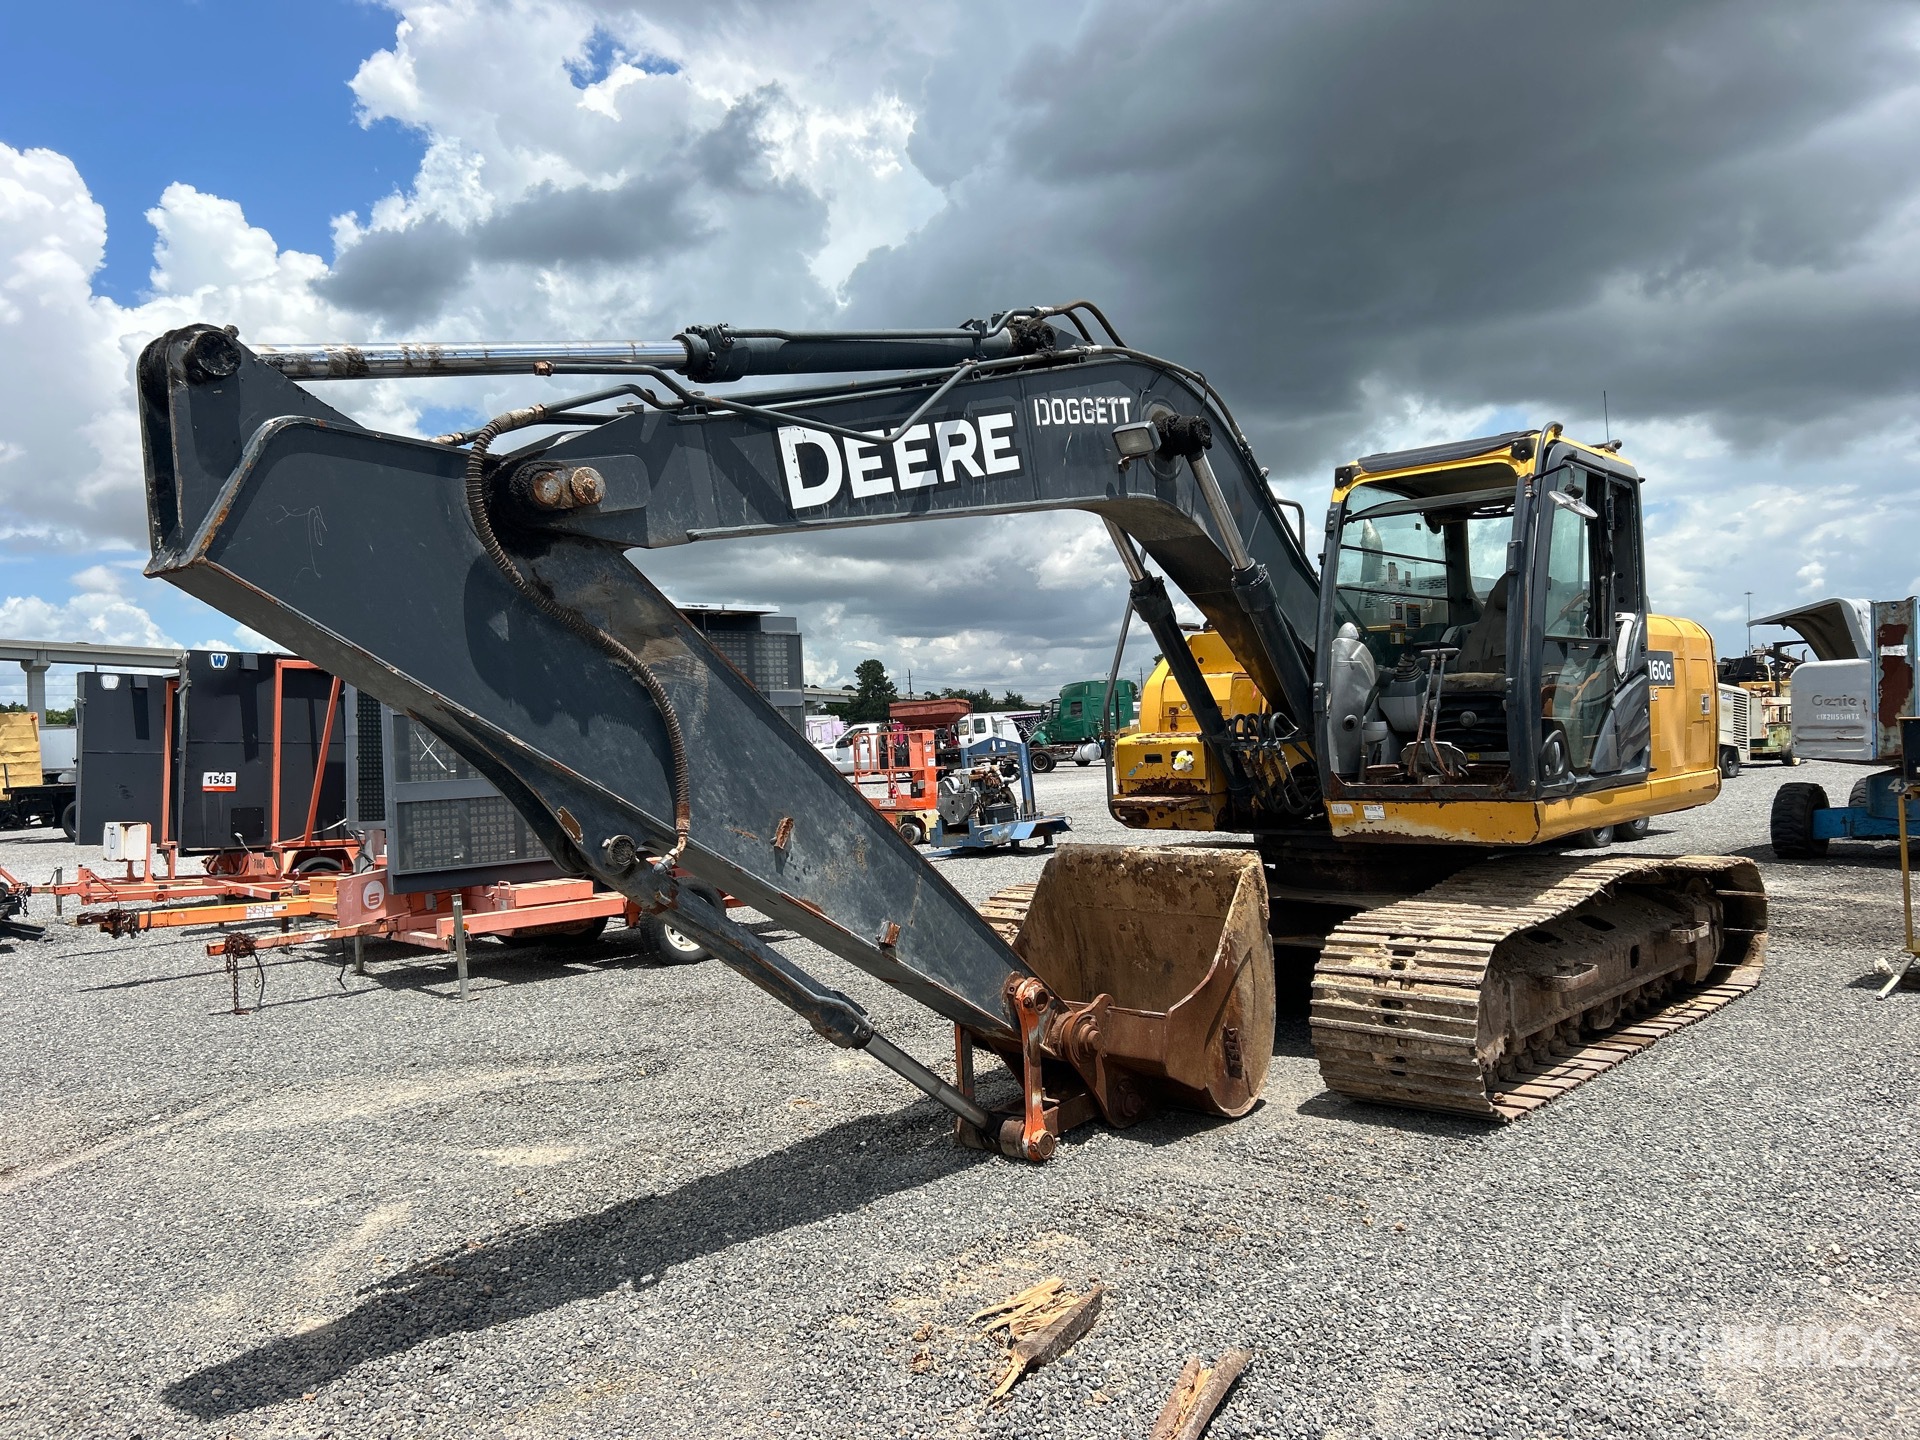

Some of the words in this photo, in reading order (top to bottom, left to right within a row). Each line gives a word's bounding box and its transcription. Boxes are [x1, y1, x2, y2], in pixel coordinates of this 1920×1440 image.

[1034, 397, 1131, 426] DOGGETT
[777, 412, 1020, 510] DEERE
[212, 654, 227, 667] W
[1647, 659, 1672, 681] 160G
[1650, 688, 1658, 701] LC
[1811, 694, 1858, 707] Genie
[207, 775, 232, 784] 1543
